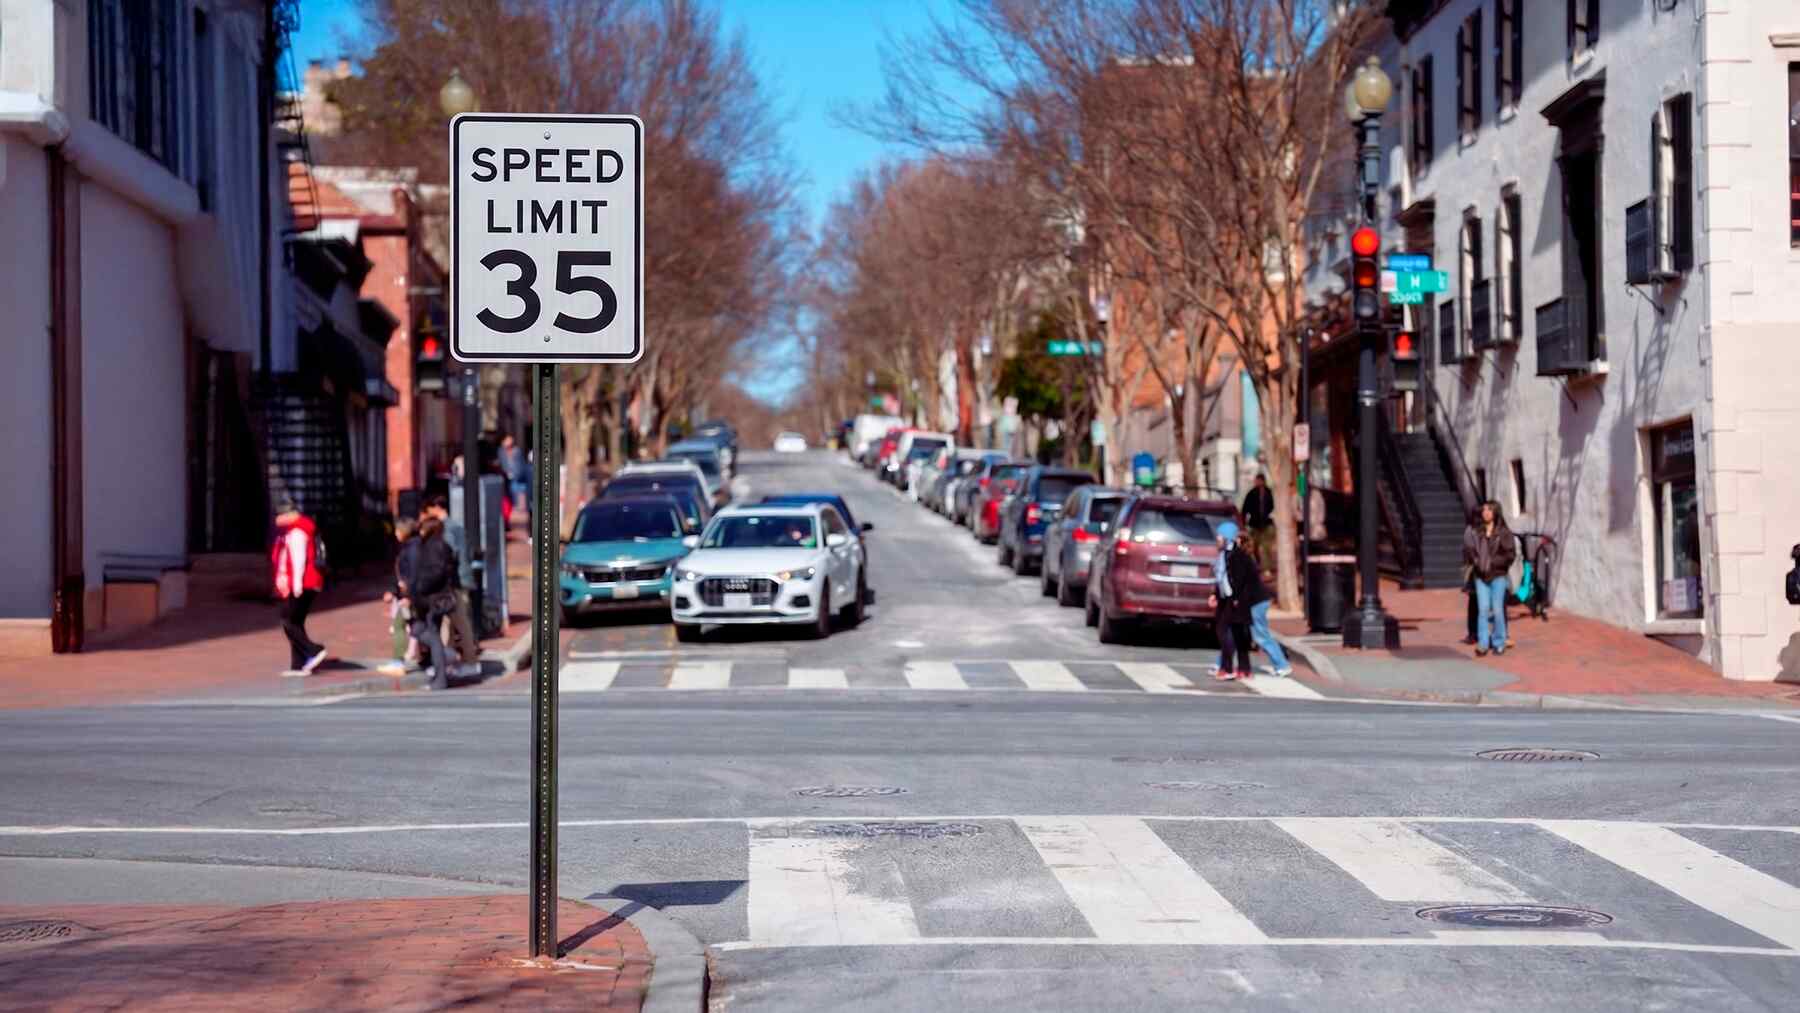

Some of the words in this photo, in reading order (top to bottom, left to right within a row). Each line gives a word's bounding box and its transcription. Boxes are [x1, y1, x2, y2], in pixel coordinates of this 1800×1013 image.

[471, 148, 624, 183] SPEED
[487, 200, 608, 234] LIMIT
[476, 249, 618, 334] 35
